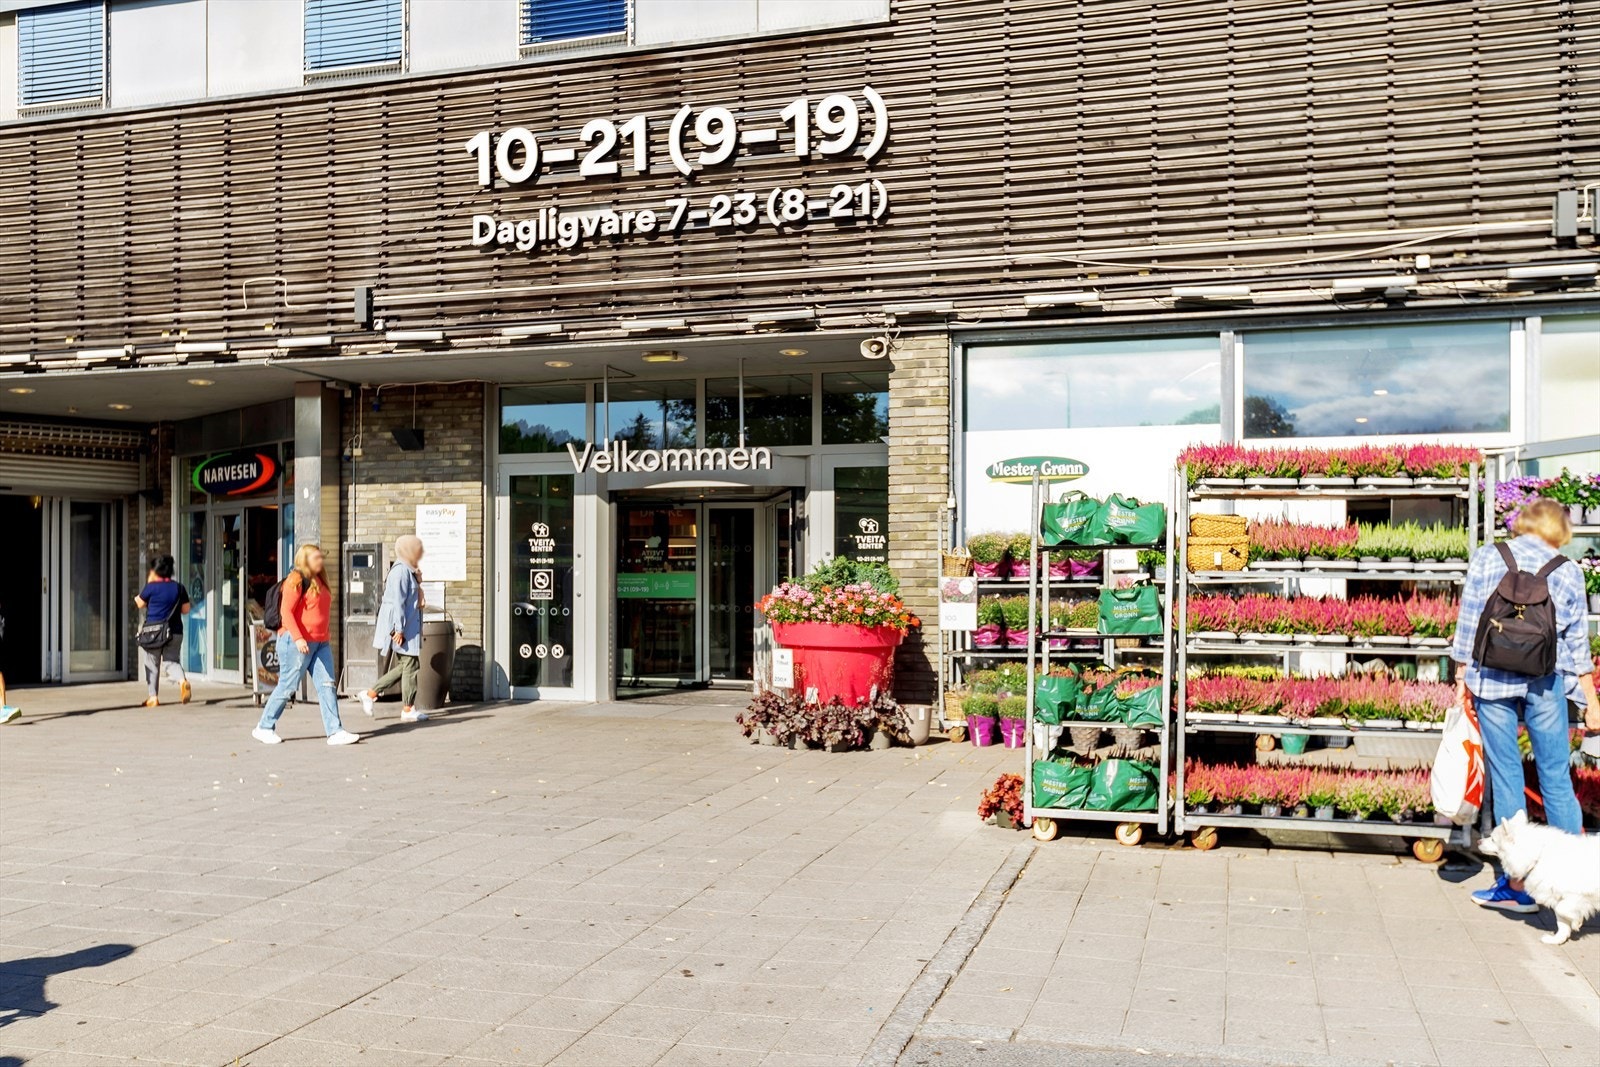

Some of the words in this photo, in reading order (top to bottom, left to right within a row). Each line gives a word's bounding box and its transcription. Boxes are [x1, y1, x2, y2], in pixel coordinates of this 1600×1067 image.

[472, 207, 657, 251] Dagligvare
[566, 440, 772, 474] Velkommen
[204, 462, 257, 485] NARVESEN
[992, 462, 1038, 477] Mester
[1040, 460, 1084, 476] Grønn
[425, 509, 456, 517] easyPay
[528, 538, 556, 547] TVEITA
[855, 535, 886, 544] TVEITA
[1113, 604, 1138, 612] MESTER
[1043, 778, 1067, 788] MESTER
